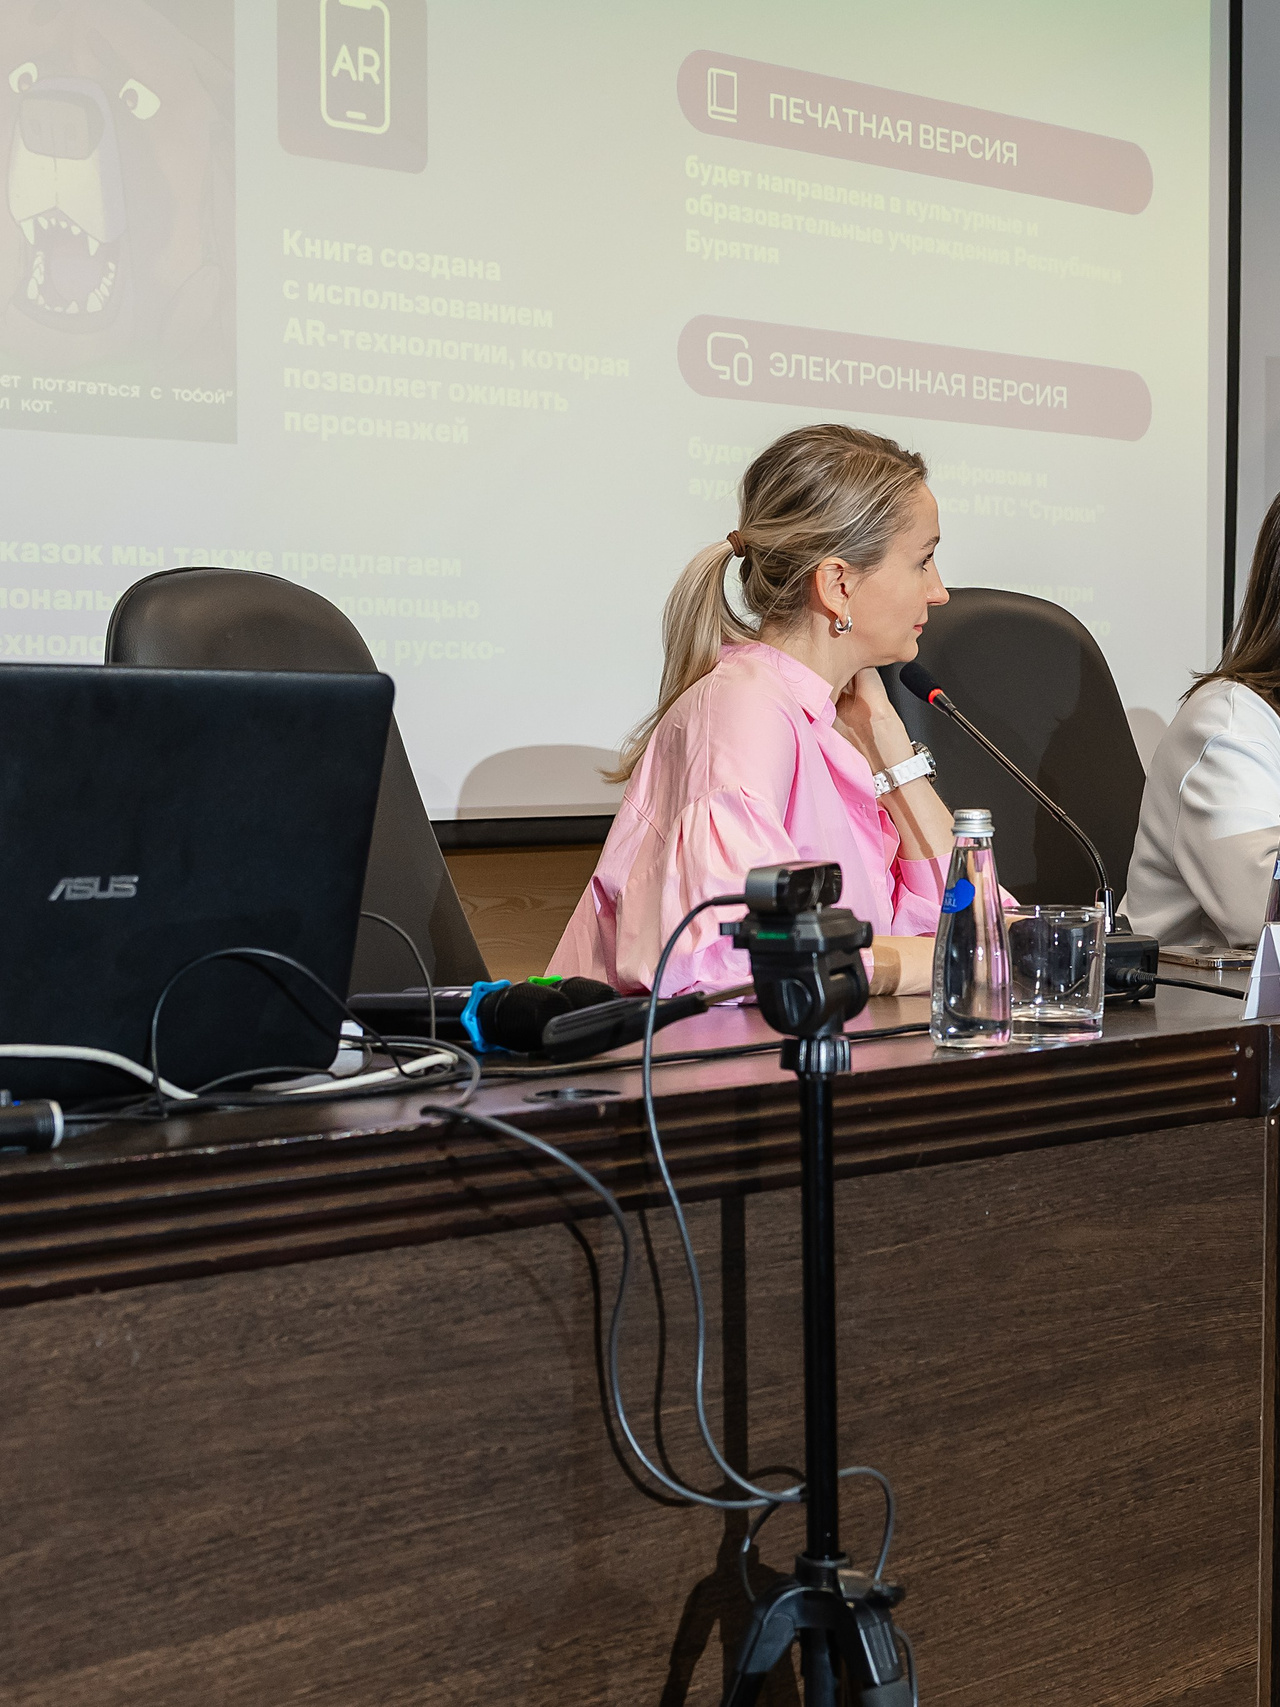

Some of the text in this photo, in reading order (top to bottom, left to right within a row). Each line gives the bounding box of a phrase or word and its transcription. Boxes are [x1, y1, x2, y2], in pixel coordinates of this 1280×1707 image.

[331, 44, 380, 85] AR
[769, 93, 1018, 166] ПЕЧАТНАЯ ВЕРСИЯ
[685, 154, 1038, 238] будет направлена в культурные и
[282, 228, 501, 281] Книга создана
[685, 194, 1122, 284] образовательные учреждения Республики
[685, 229, 780, 265] Бурятия
[282, 279, 553, 329] с использованием
[282, 317, 630, 380] AR-технологии, которая
[32, 376, 141, 398] потягаться
[150, 386, 162, 400] с
[284, 367, 568, 412] позволяет оживить
[769, 352, 1068, 409] ЭЛЕКТРОННАЯ ВЕРСИЯ
[21, 399, 57, 413] кот.
[284, 411, 469, 444] персонажей
[974, 494, 1016, 517] МТС
[112, 544, 164, 567] мы
[173, 546, 273, 570] также
[281, 550, 464, 579] предлагаем
[395, 640, 505, 667] русско-
[48, 875, 140, 901] ASUS
